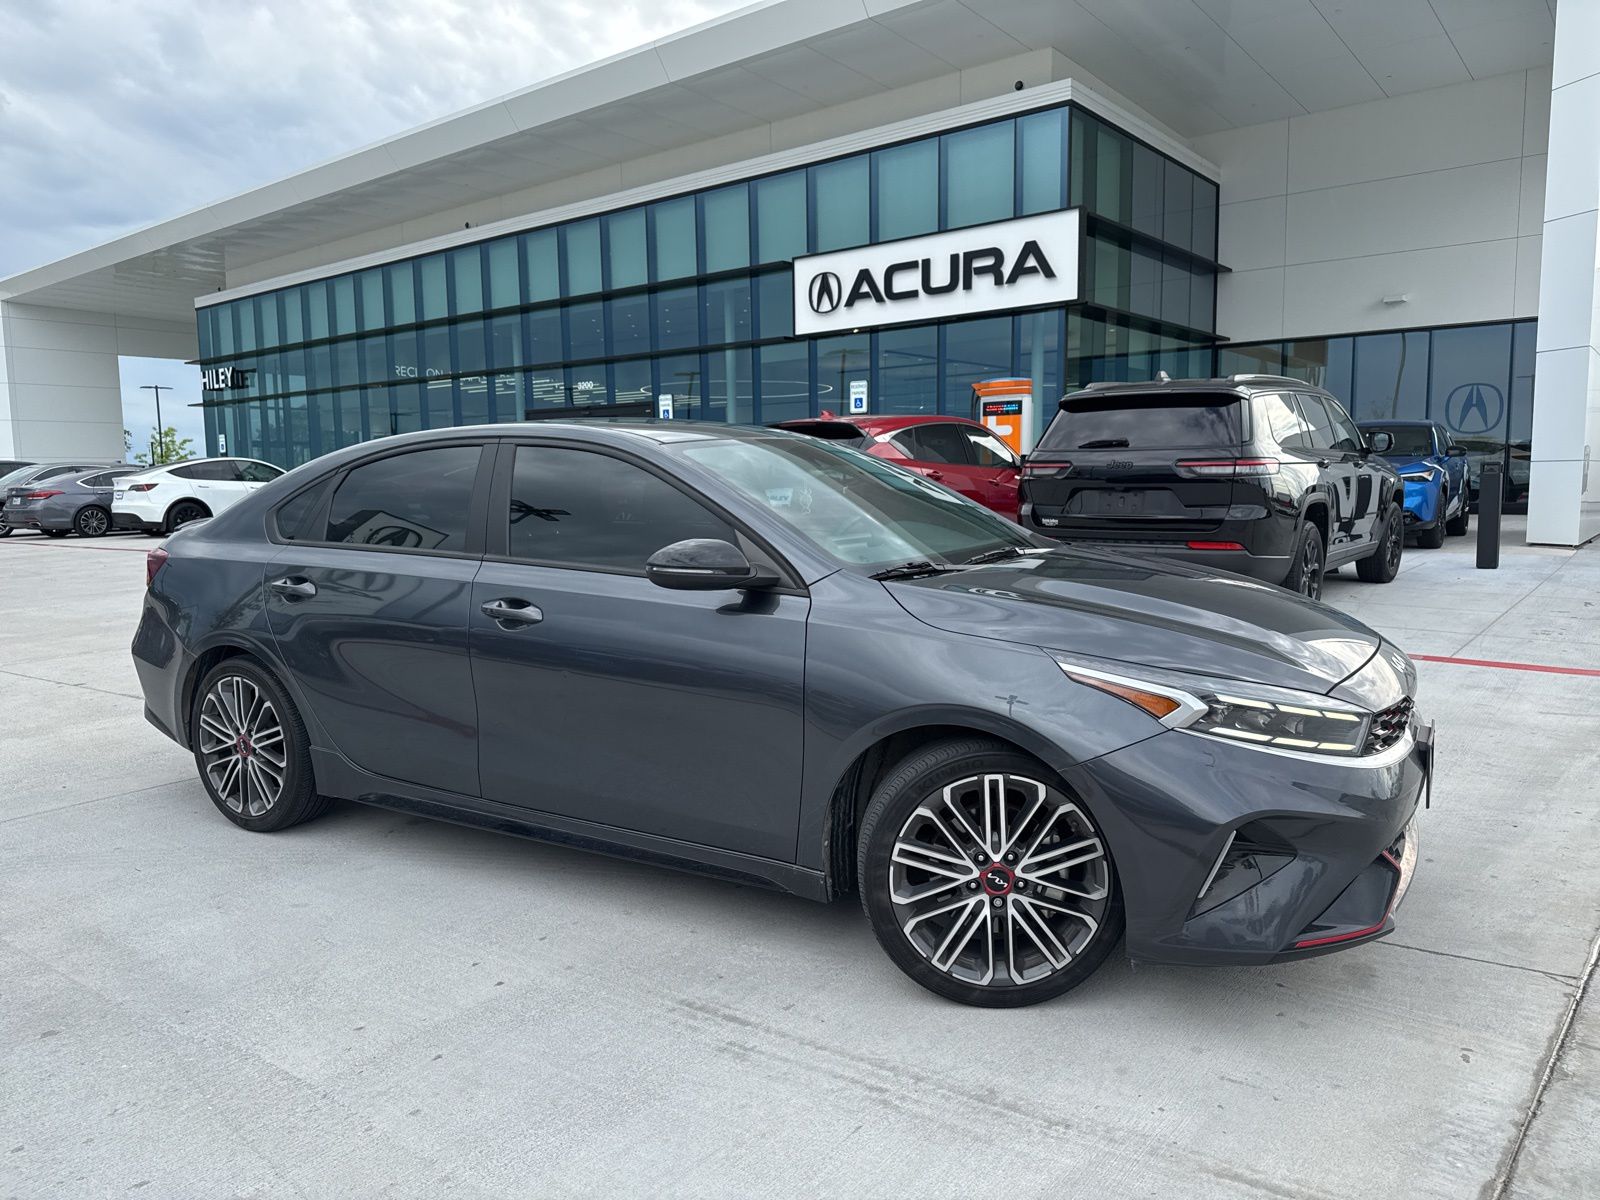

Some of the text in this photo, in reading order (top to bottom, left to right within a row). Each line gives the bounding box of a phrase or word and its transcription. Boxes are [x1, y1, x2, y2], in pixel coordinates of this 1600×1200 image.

[844, 240, 1056, 307] ACURA
[200, 366, 232, 390] HILEY
[577, 381, 594, 390] 3200
[1106, 459, 1133, 470] Jeep
